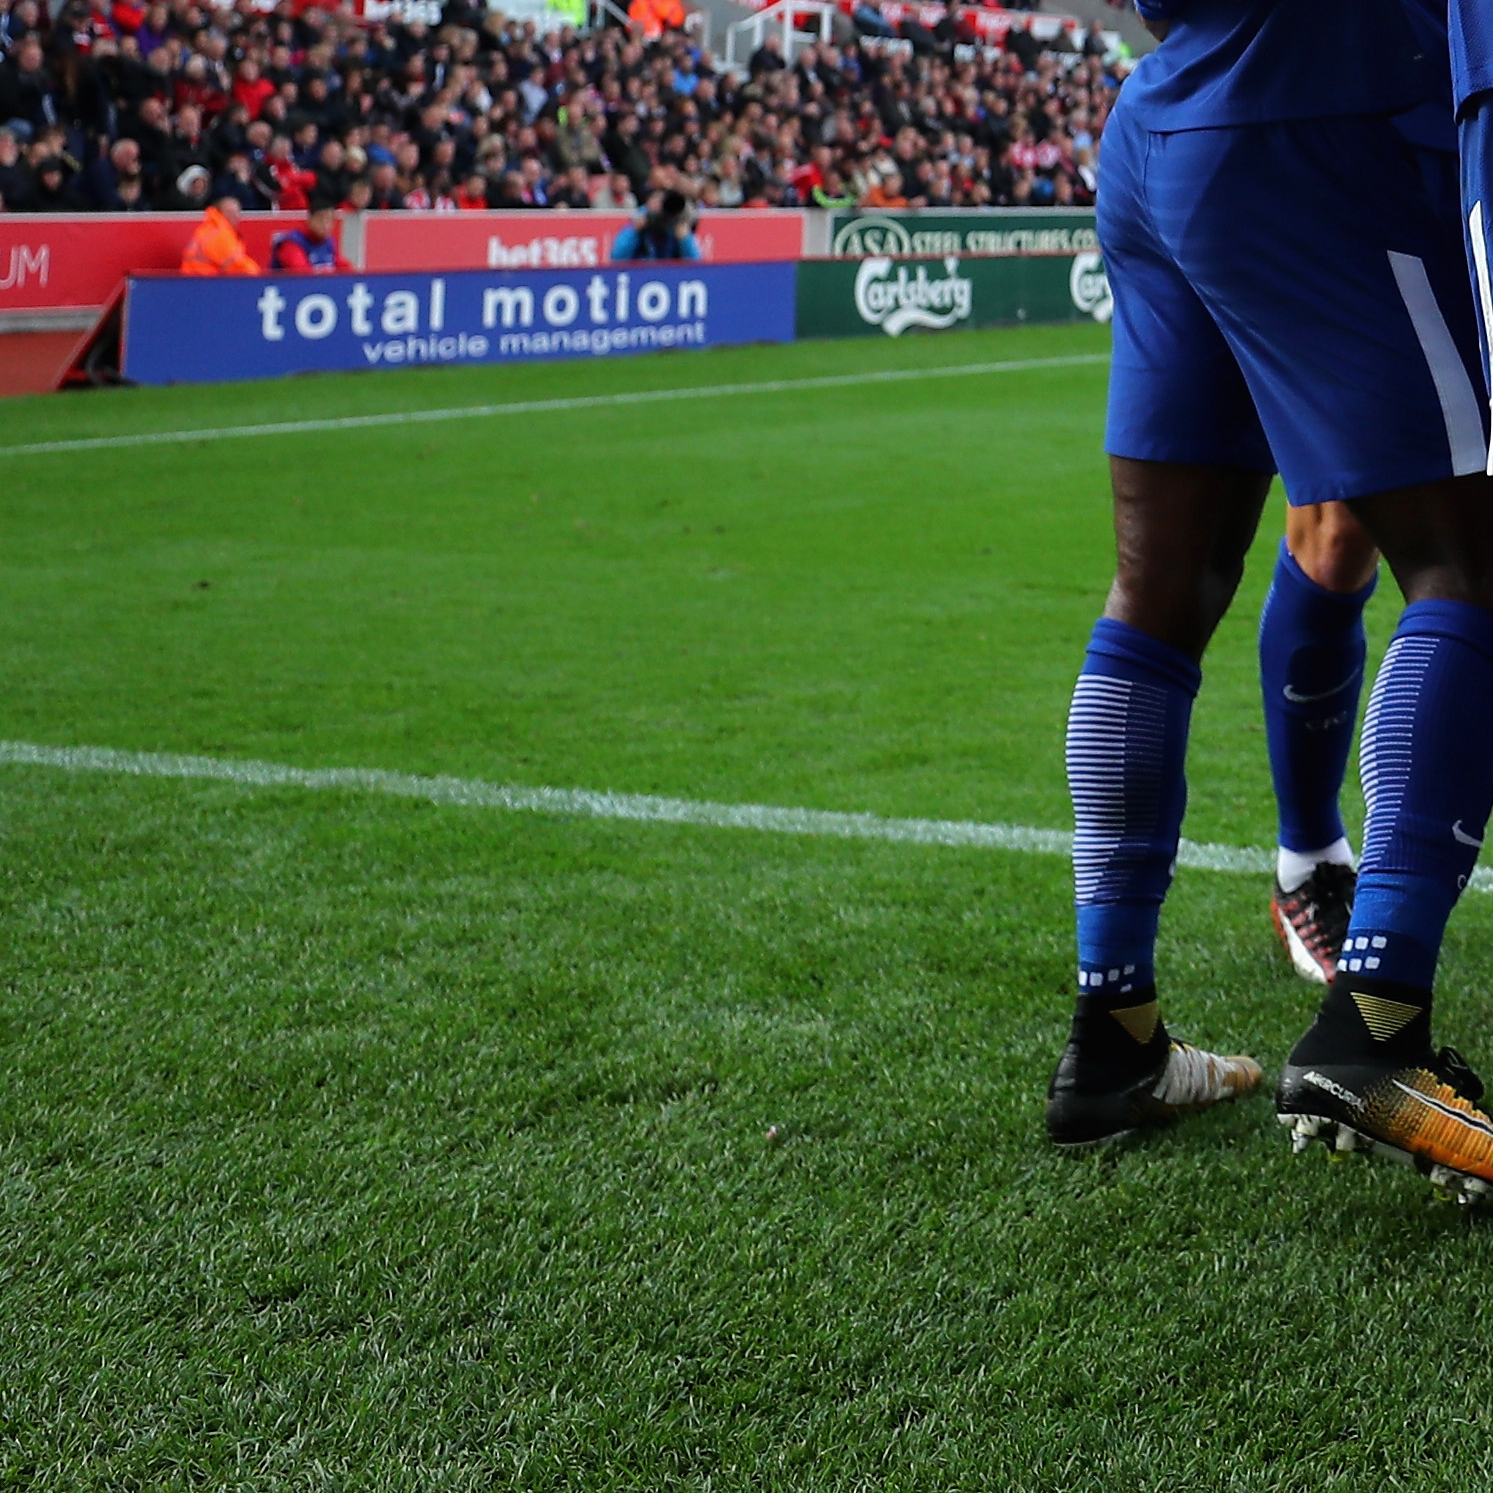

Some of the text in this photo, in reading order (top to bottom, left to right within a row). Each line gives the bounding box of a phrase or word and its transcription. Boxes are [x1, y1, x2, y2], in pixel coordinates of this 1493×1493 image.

[257, 271, 709, 342] total motion
[855, 256, 973, 337] Carlsberg
[363, 320, 706, 365] vehicle management
